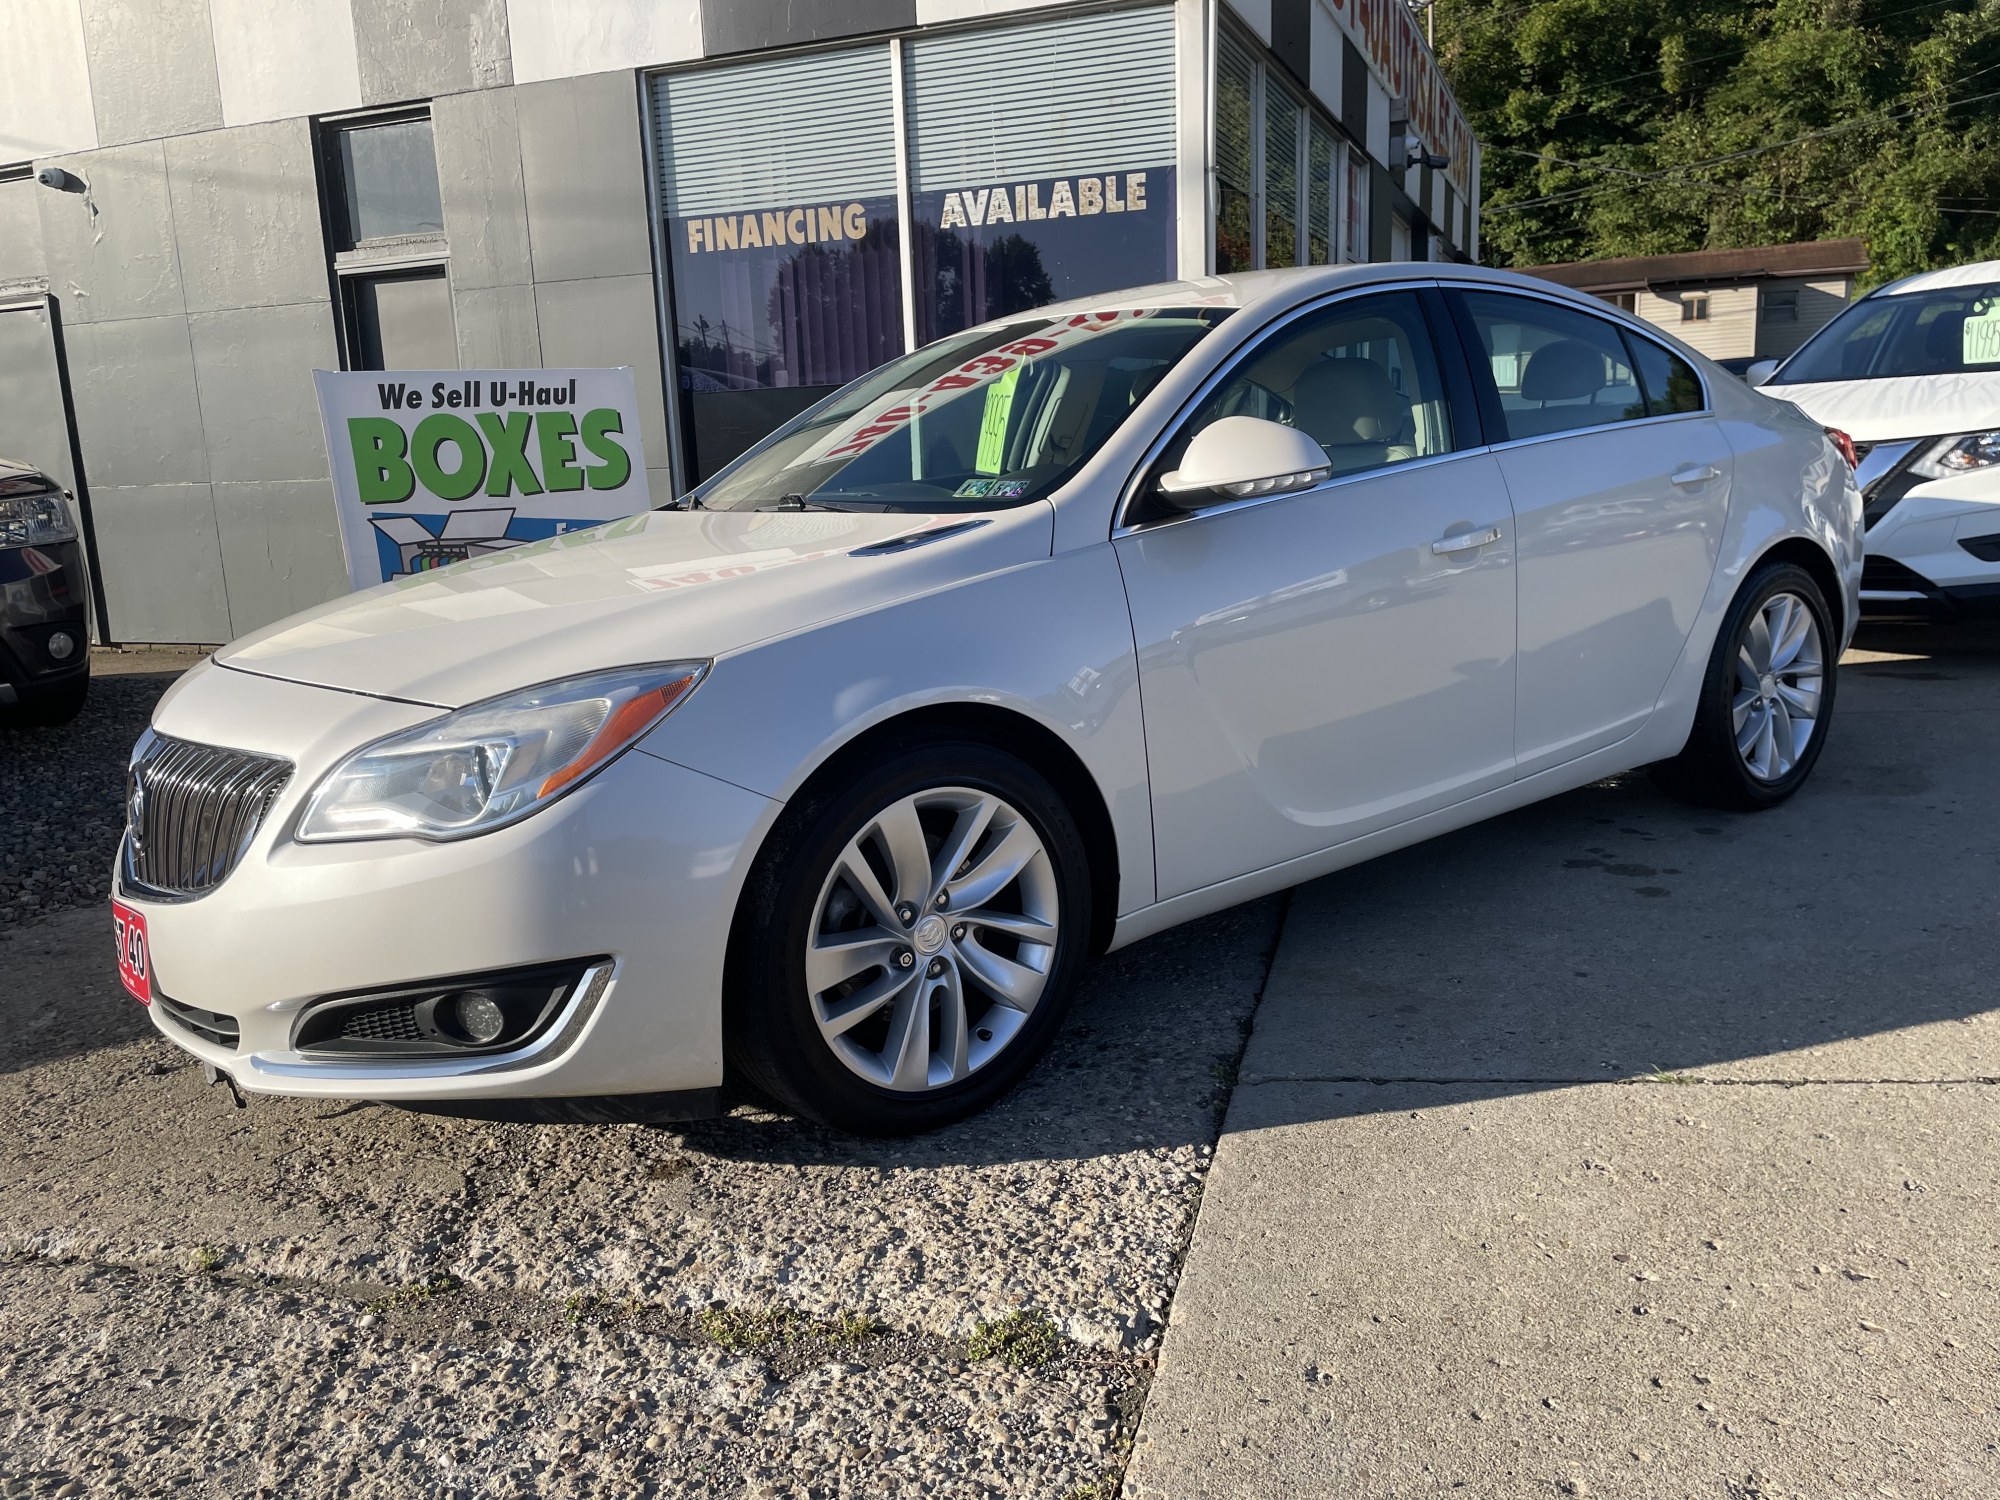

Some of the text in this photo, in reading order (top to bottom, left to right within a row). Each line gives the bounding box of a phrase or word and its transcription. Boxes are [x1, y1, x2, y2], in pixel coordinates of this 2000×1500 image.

[686, 172, 1147, 254] FINANCING AVAILABLE
[377, 378, 577, 410] We Sell U-Haul
[347, 408, 632, 505] BOXES
[128, 924, 146, 980] 40
